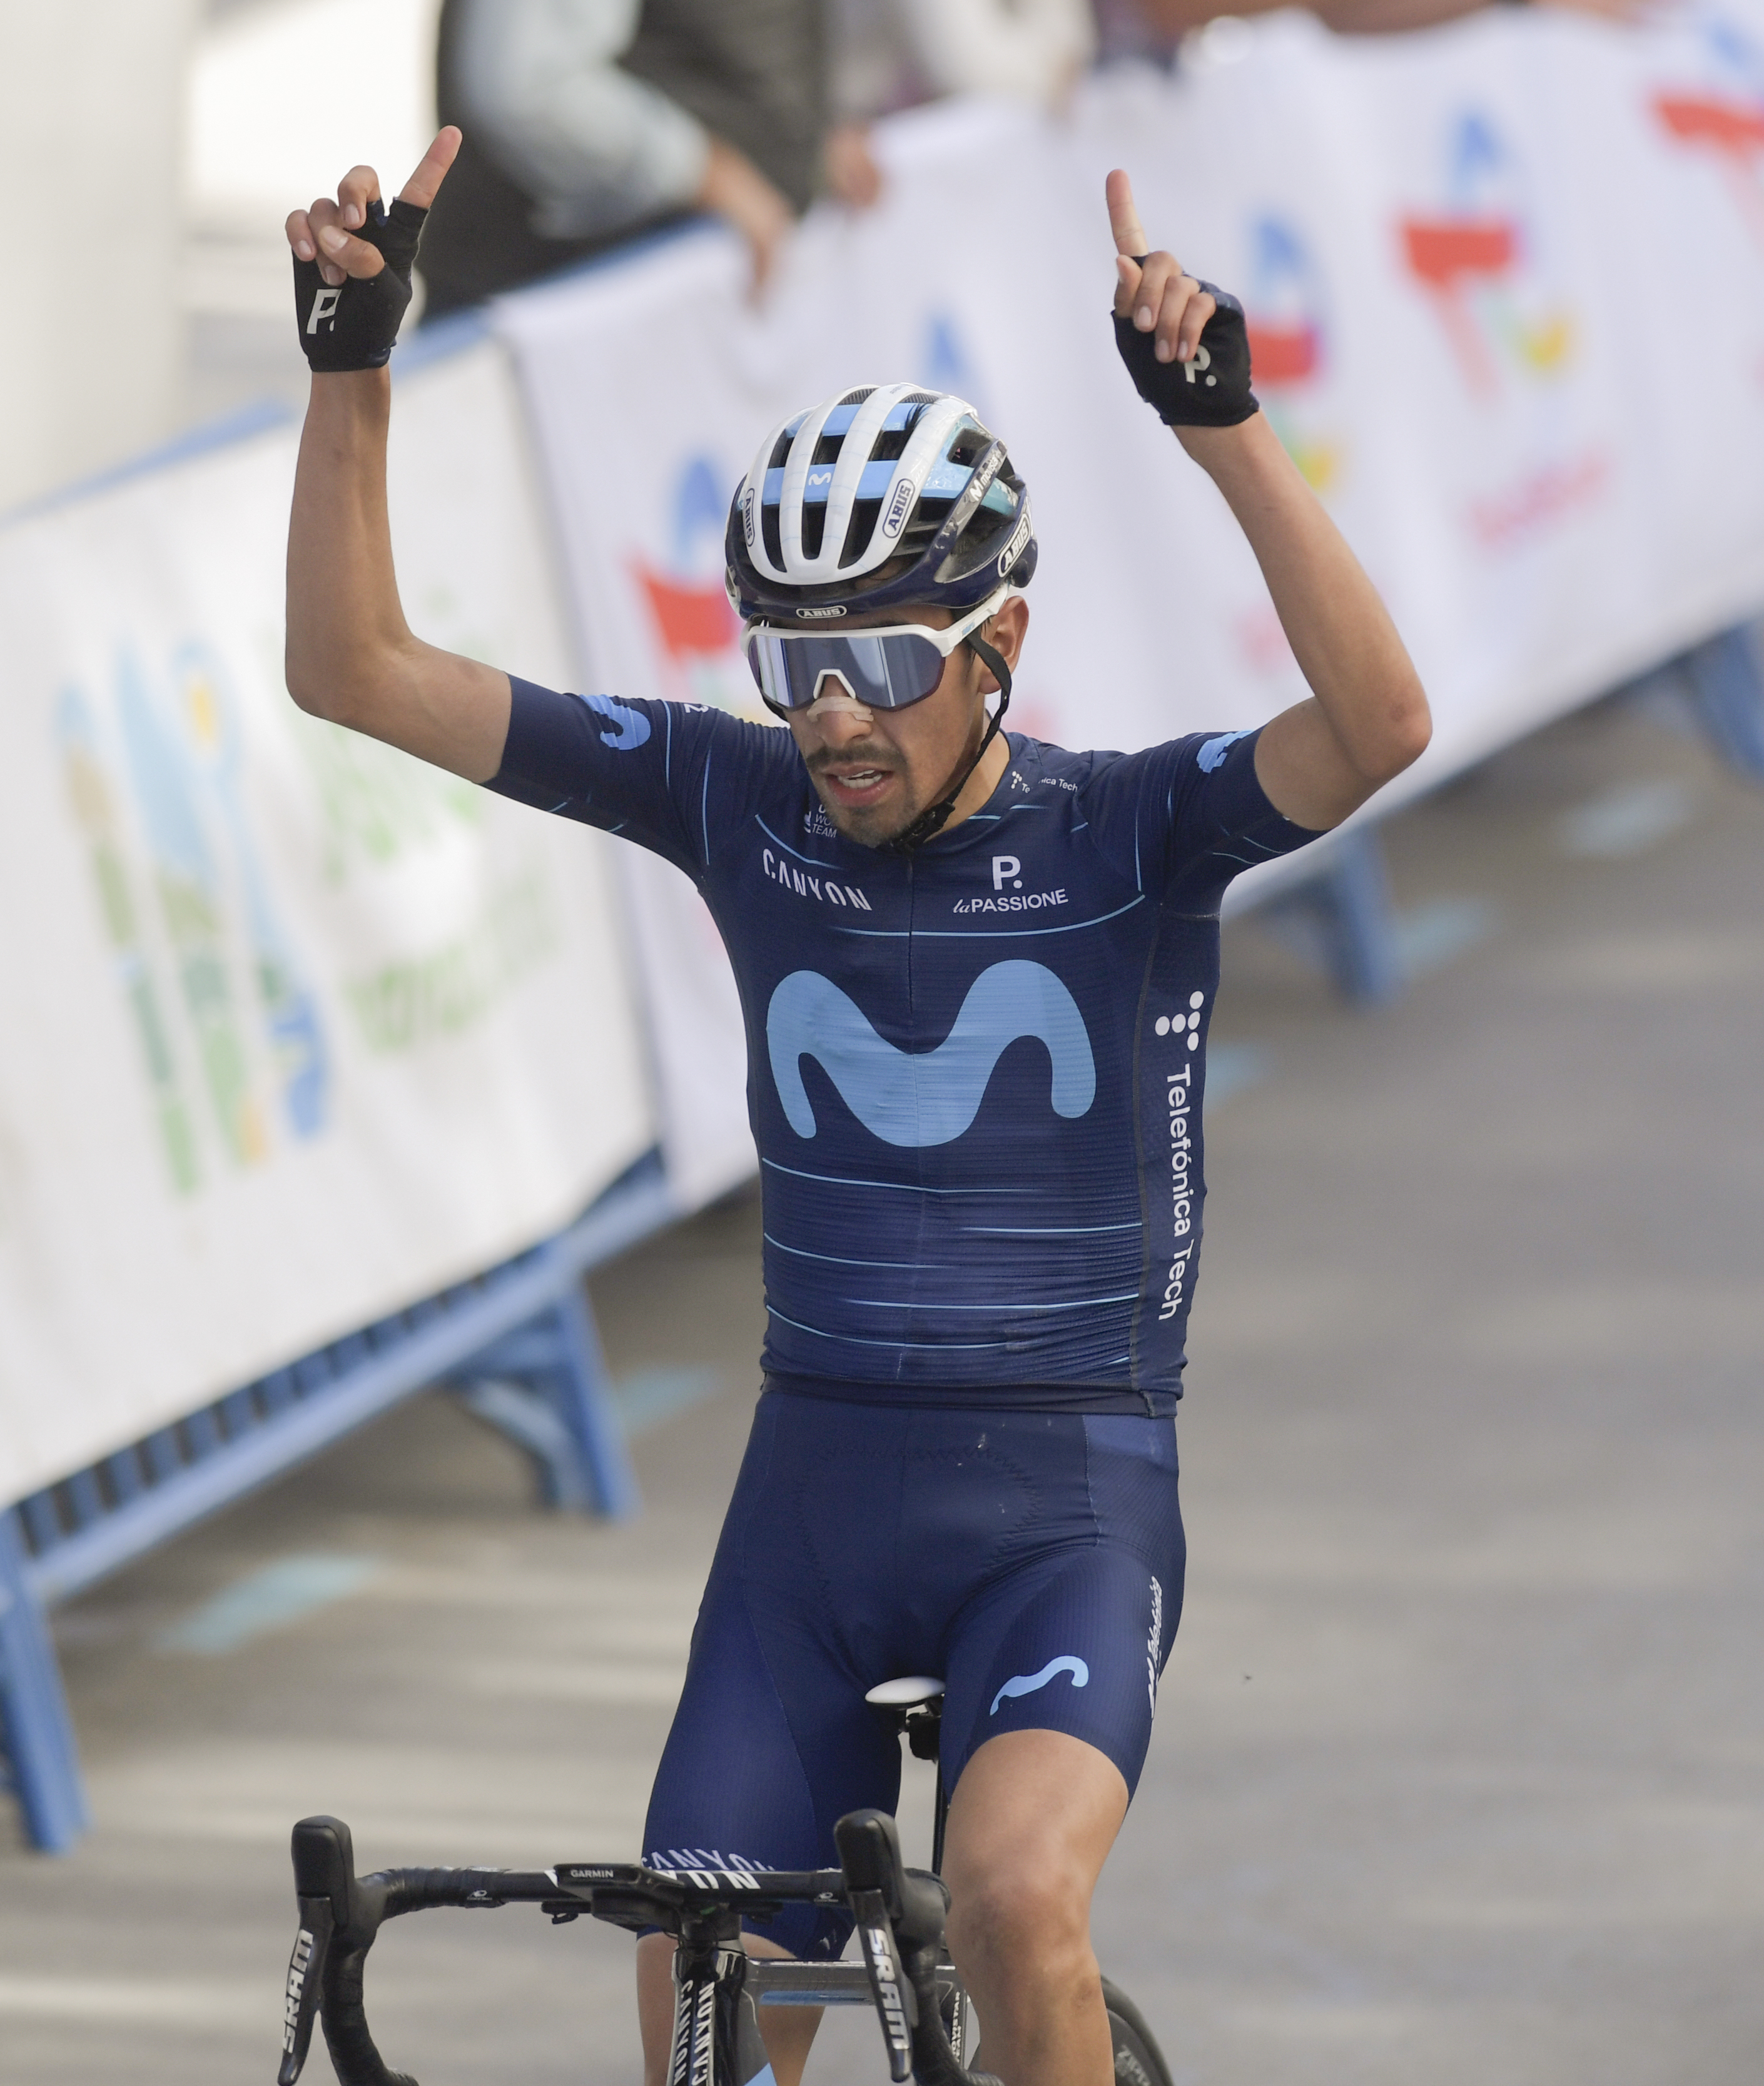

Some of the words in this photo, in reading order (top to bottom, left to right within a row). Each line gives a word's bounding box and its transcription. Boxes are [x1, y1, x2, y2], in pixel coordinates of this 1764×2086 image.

[888, 485, 913, 531] ABUS
[1005, 521, 1028, 571] ABUS
[804, 608, 841, 617] ABUS
[1059, 778, 1078, 792] Tech
[813, 823, 837, 838] TEAM
[763, 848, 873, 911] CANYON
[992, 855, 1023, 890] P.
[1167, 1063, 1194, 1238] Telefónica
[1158, 1238, 1195, 1321] Tech
[570, 1869, 614, 1878] GARMIN
[283, 1929, 313, 2053] SRAM
[868, 1929, 910, 2050] SRAM
[674, 1980, 693, 2086] CANYON
[692, 1982, 715, 2086] CANYON
